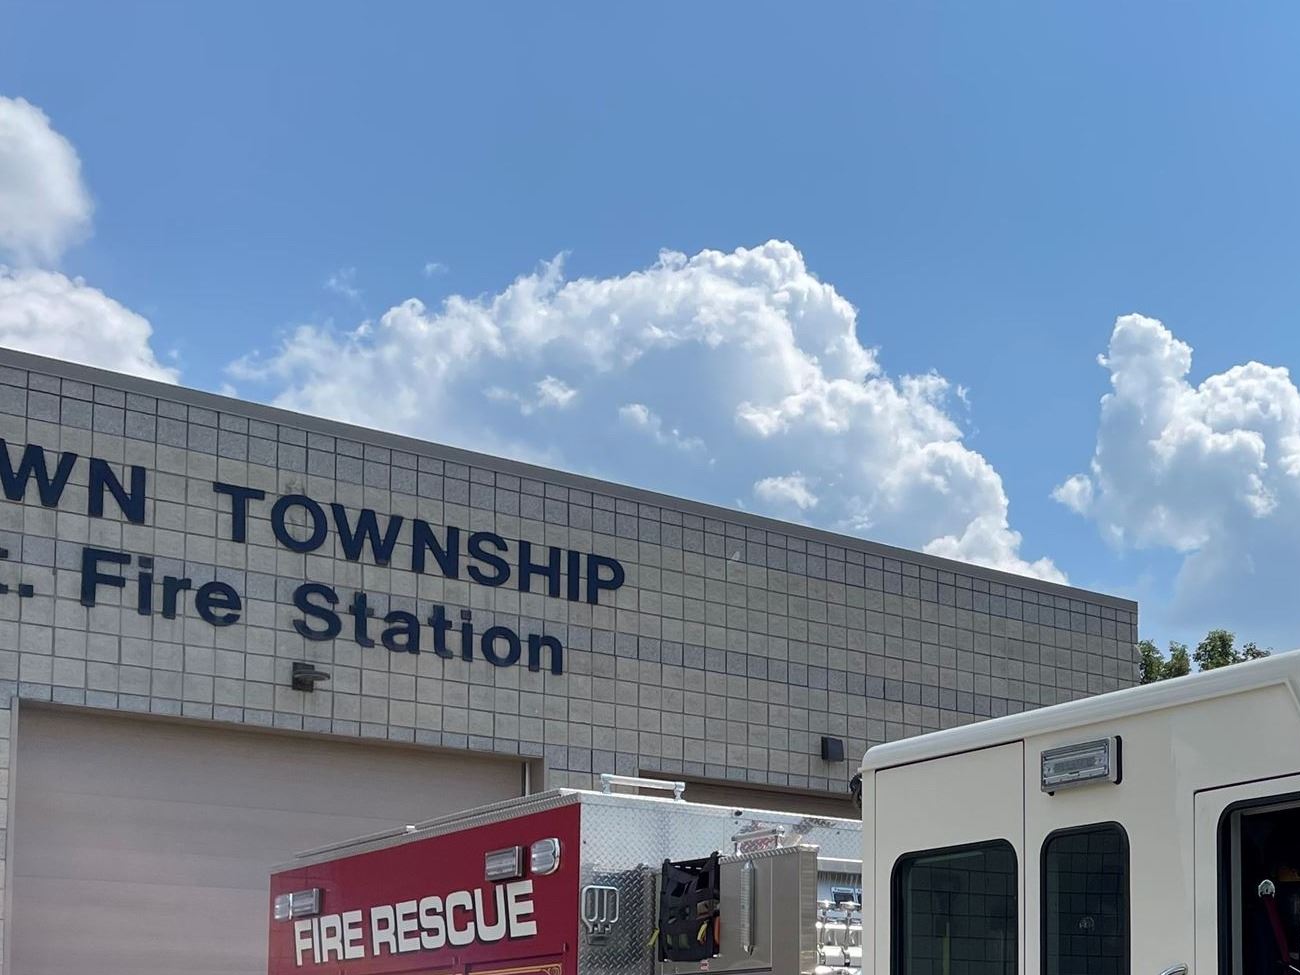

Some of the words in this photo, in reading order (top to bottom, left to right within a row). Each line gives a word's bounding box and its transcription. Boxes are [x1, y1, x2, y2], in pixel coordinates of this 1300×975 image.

[0, 438, 146, 525] WN
[213, 481, 626, 605] TOWNSHIP
[80, 547, 242, 627] Fire
[293, 582, 563, 676] Station
[294, 909, 365, 967] FIRE
[370, 879, 538, 956] RESCUE
